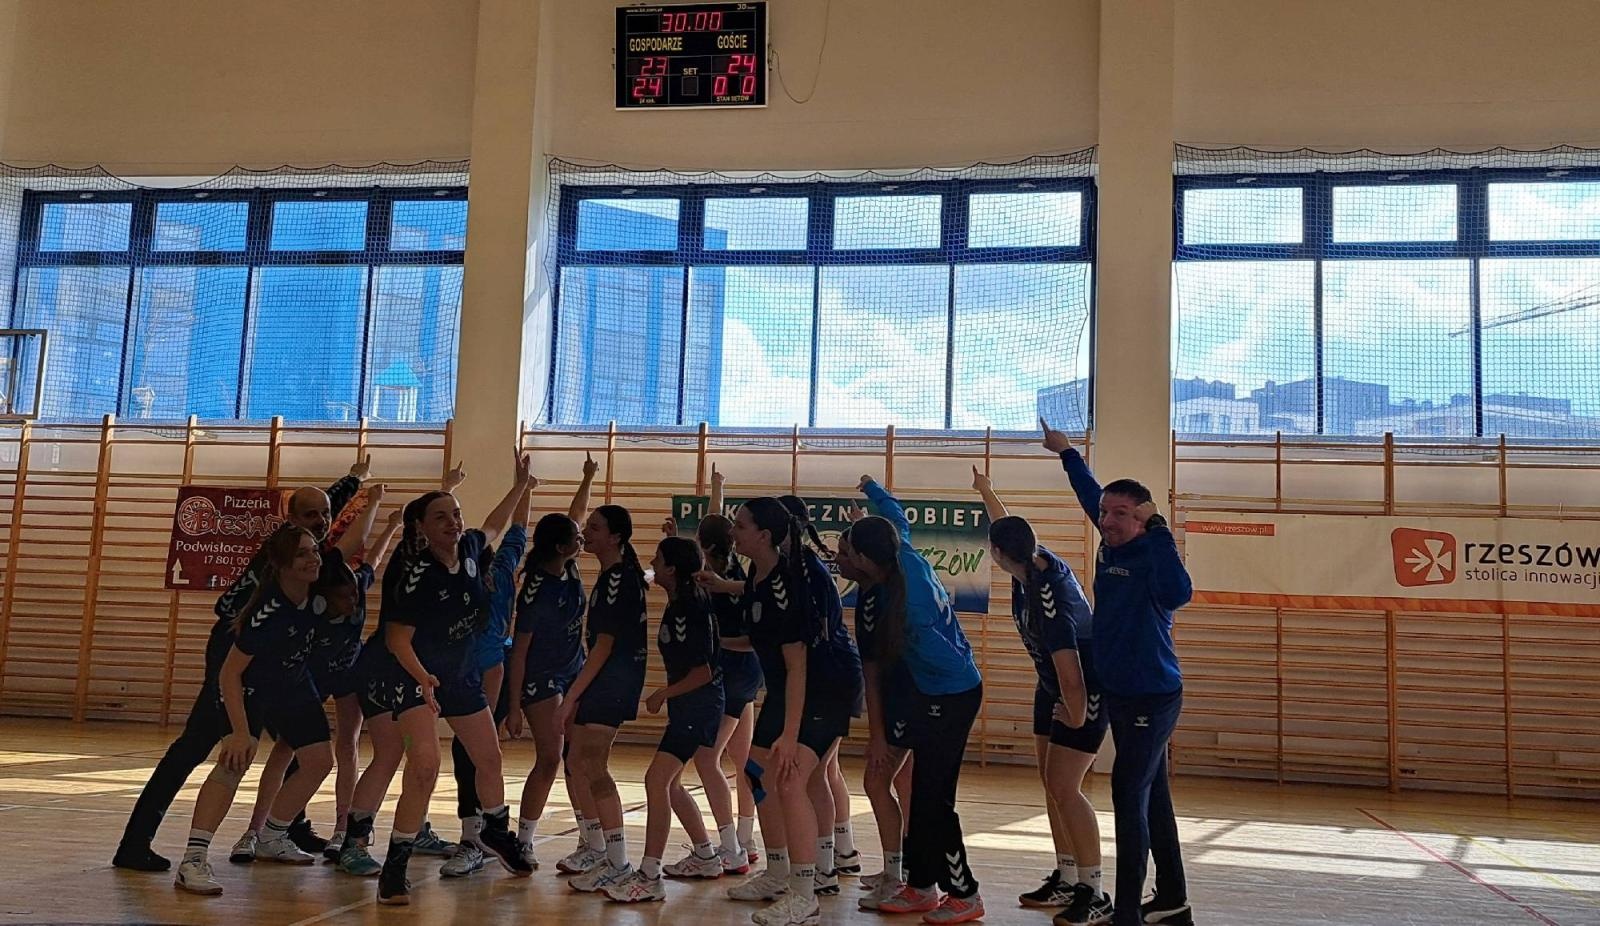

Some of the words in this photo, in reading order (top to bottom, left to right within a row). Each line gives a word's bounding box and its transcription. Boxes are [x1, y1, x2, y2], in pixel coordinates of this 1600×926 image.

[661, 12, 721, 32] 30.00
[629, 37, 683, 51] GOSPODARZE
[717, 32, 748, 49] GOŚCIE
[641, 57, 668, 76] 23
[728, 55, 756, 74] 24
[633, 78, 661, 97] 24
[224, 495, 270, 509] Pizzeria
[904, 507, 984, 527] OBIET
[1201, 524, 1267, 535] www.rzeszow.pl
[176, 541, 253, 554] Podwisłocze
[1464, 542, 1600, 567] rzeszów
[204, 555, 213, 565] 17
[215, 556, 233, 565] 801
[1464, 567, 1518, 583] stolica
